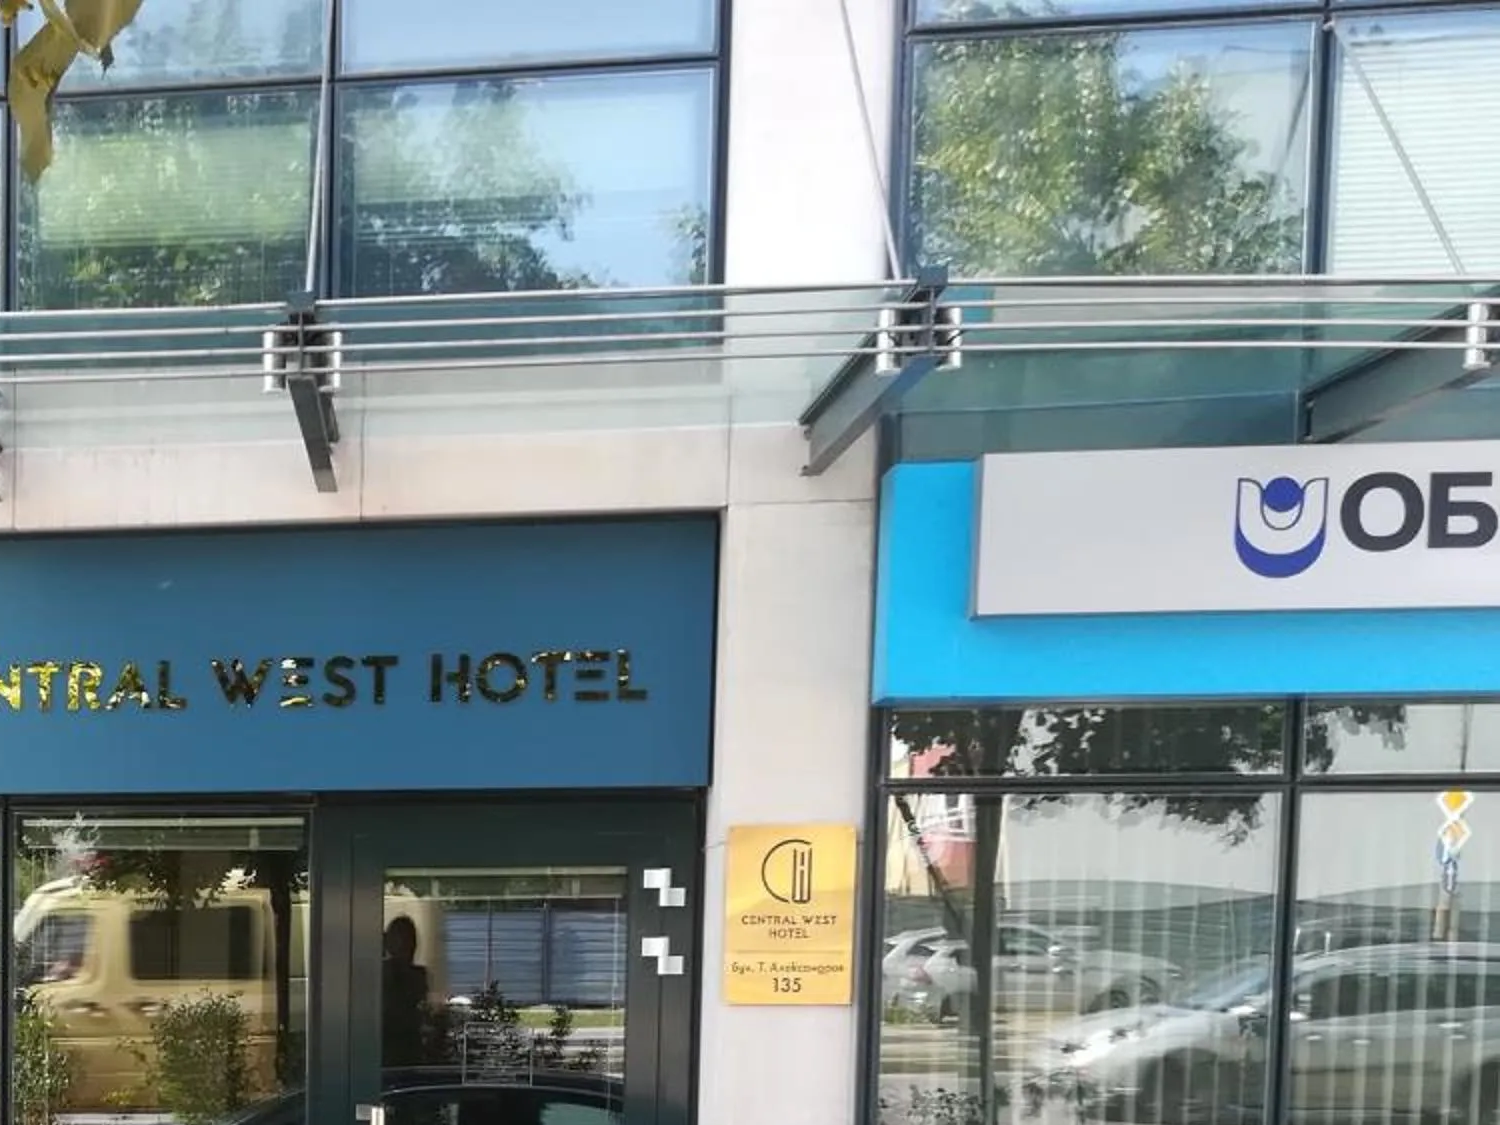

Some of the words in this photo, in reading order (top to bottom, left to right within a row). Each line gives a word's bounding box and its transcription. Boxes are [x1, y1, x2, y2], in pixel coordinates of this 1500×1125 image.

[208, 655, 399, 708] WEST
[429, 649, 648, 704] HOTEL
[741, 915, 797, 926] CENTRAL
[802, 915, 837, 926] WEST
[768, 928, 811, 939] HOTEL
[772, 977, 802, 993] 135
